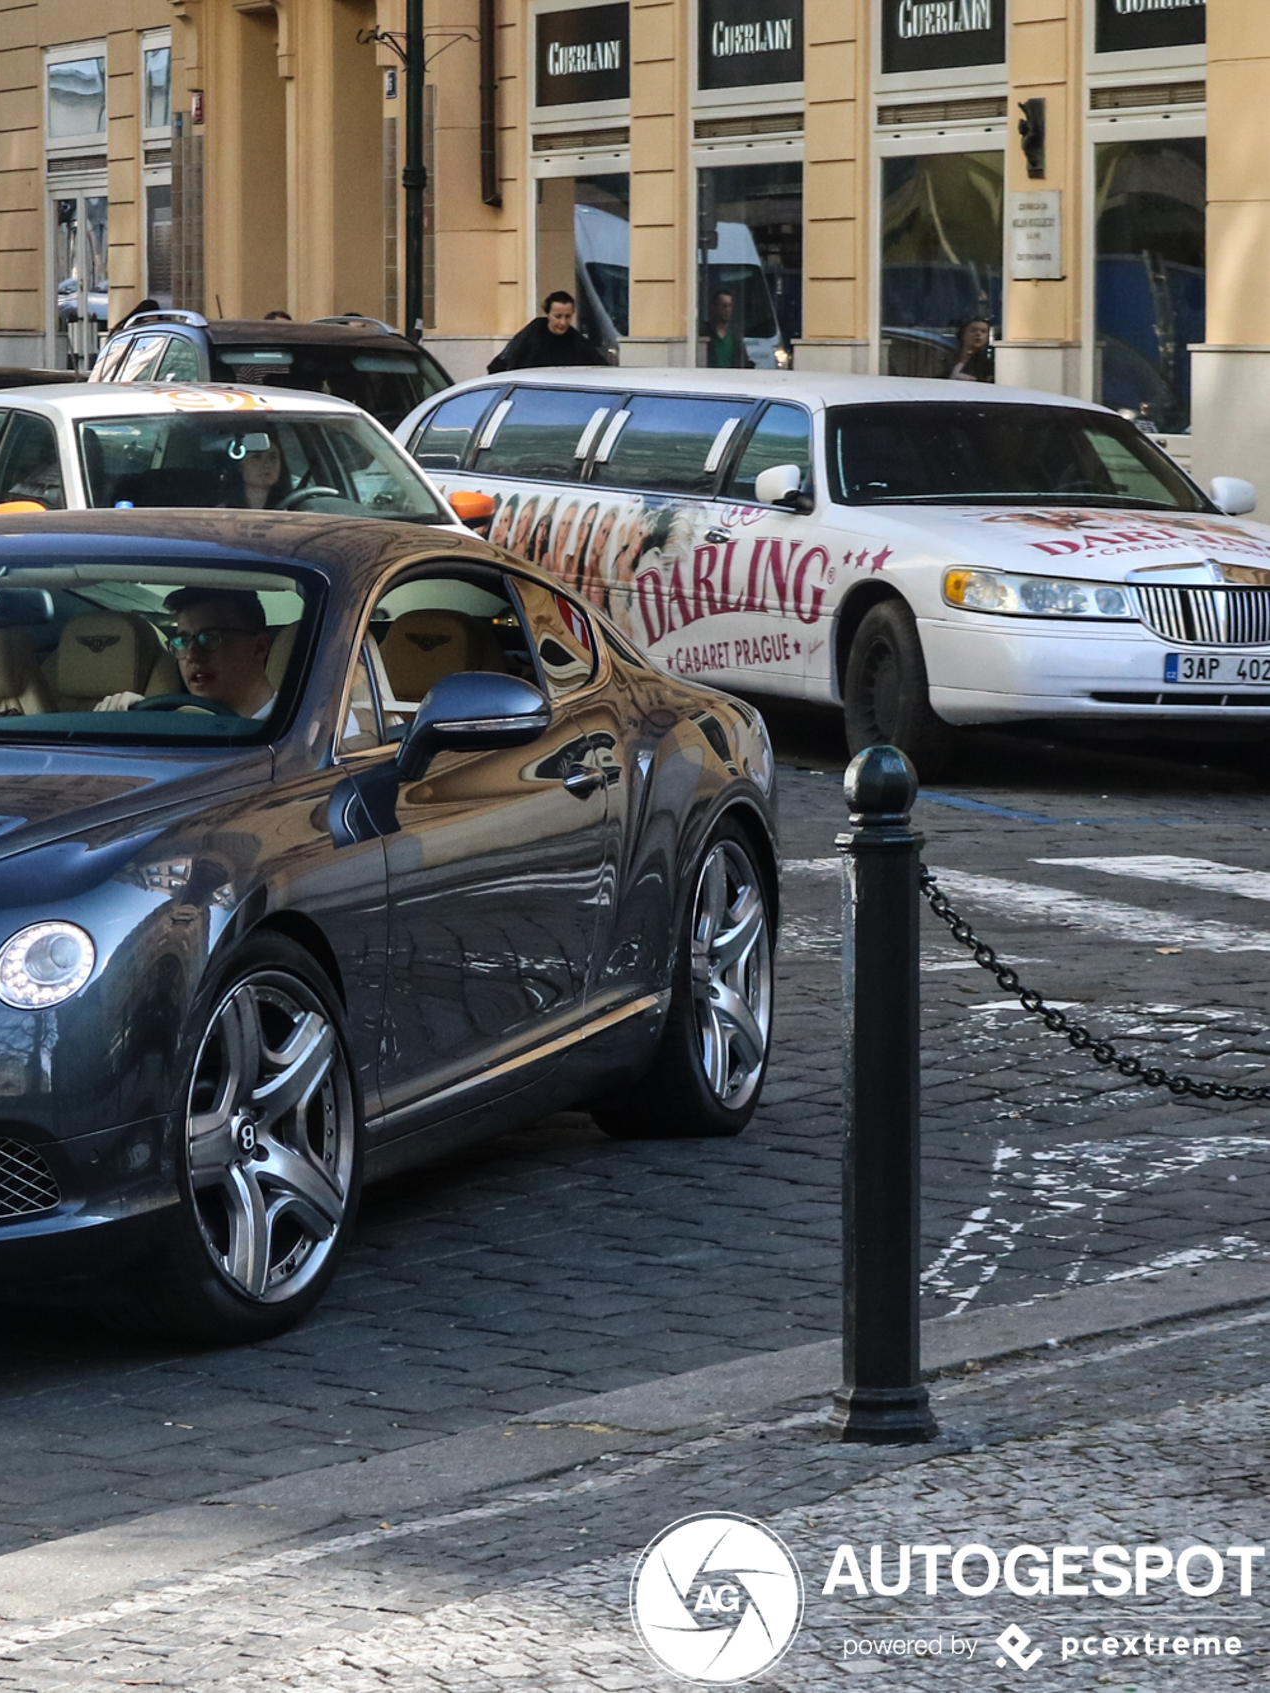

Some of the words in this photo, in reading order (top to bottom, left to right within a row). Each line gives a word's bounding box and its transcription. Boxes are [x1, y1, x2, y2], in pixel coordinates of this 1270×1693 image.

[898, 0, 991, 38] GUERLAIN
[712, 18, 792, 58] GUERLAIN
[548, 40, 621, 77] GUERLAIN
[1027, 528, 1270, 557] DARLIN
[1099, 541, 1191, 556] CABARET
[636, 537, 830, 648] DARLING
[676, 641, 730, 674] CABARET
[733, 633, 791, 667] PRAGUE
[1183, 657, 1220, 680] 3AP
